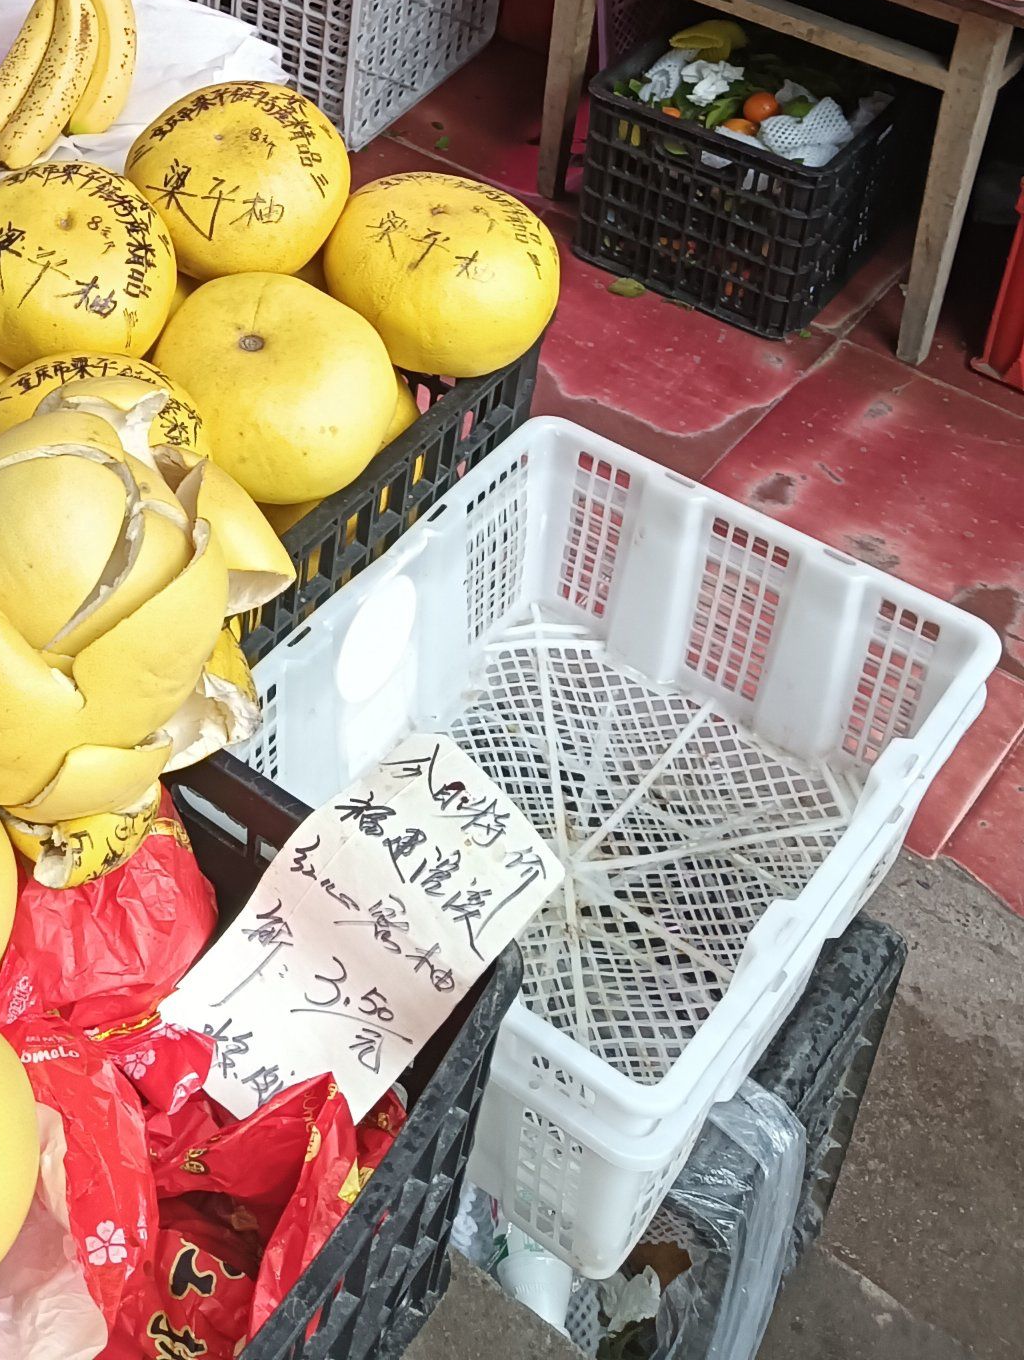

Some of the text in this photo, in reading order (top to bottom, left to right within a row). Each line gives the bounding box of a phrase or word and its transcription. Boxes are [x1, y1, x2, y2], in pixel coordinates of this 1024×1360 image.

[145, 157, 285, 242] 梁平柚
[290, 833, 454, 993] 红心蜜柚
[381, 743, 547, 939] 今日特价
